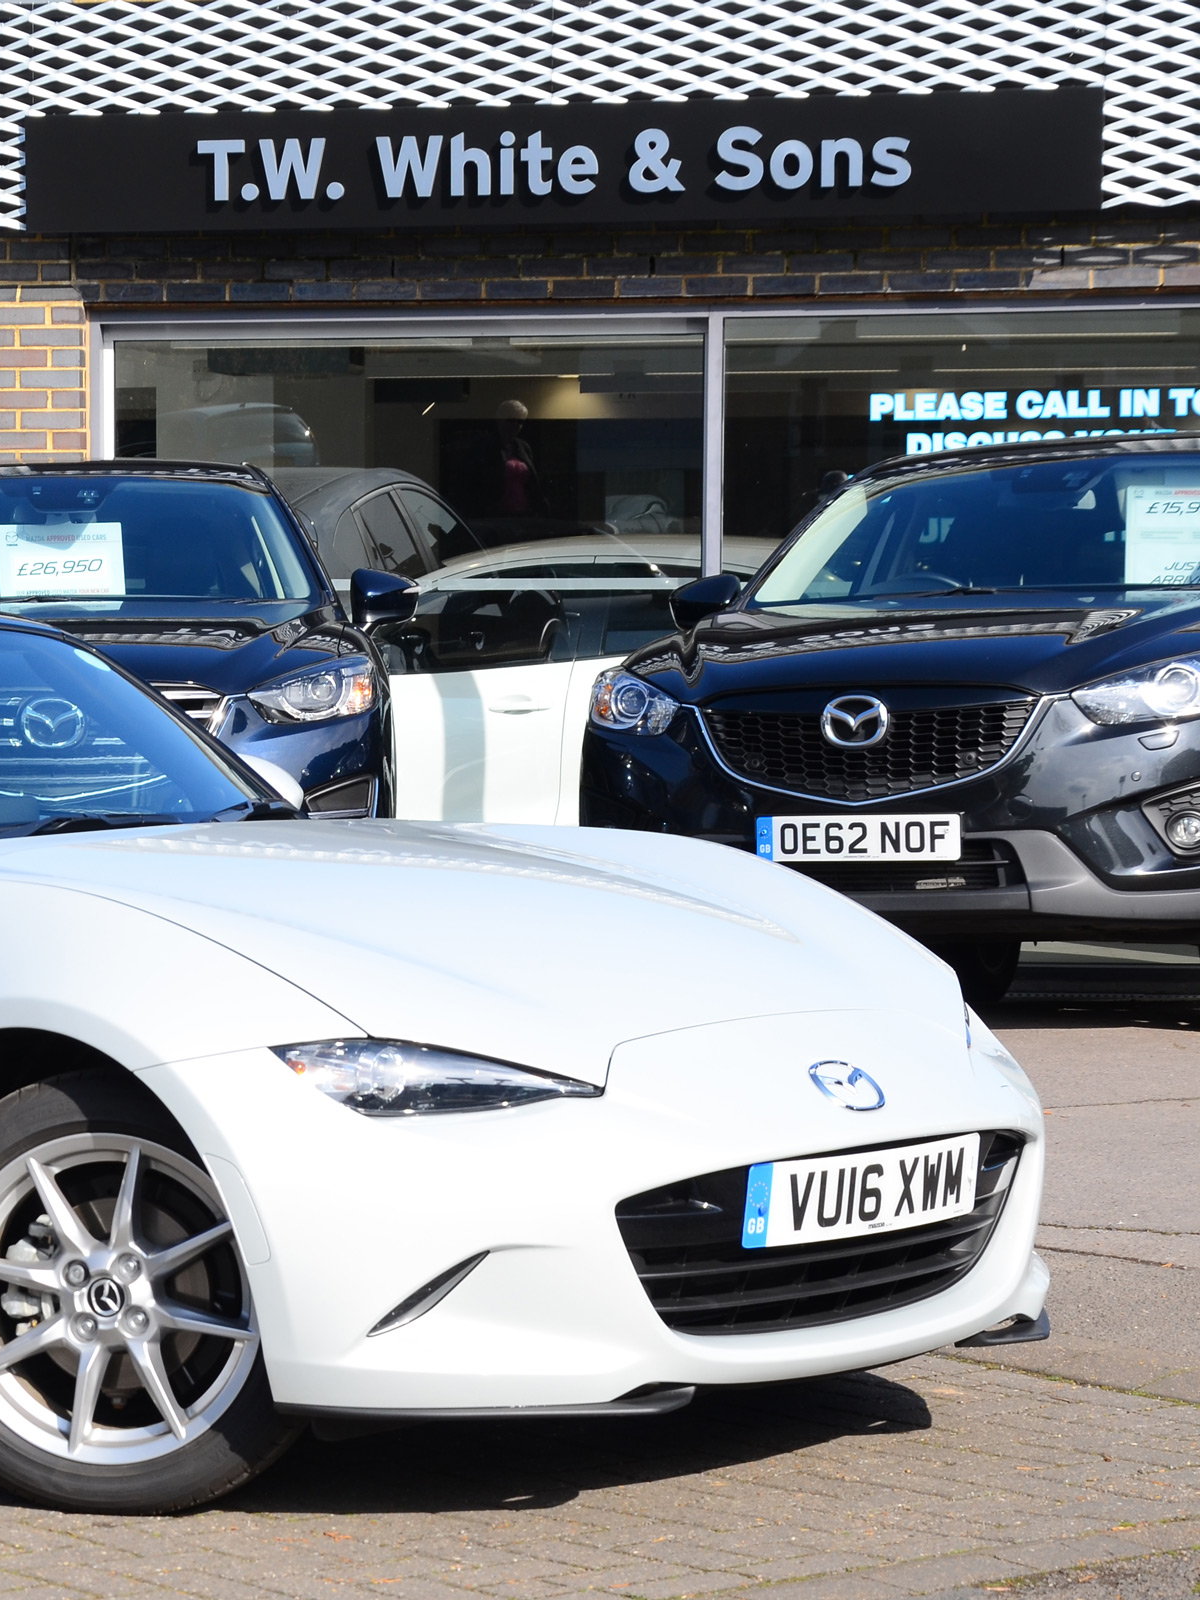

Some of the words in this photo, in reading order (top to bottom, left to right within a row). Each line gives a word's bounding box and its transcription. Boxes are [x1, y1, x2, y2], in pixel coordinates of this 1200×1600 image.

[197, 137, 345, 201] T.W.
[376, 130, 599, 197] White
[628, 128, 686, 193] &
[714, 125, 912, 191] Sons
[869, 391, 1008, 421] PLEASE
[1015, 389, 1111, 419] CALL
[1119, 388, 1160, 417] IN
[1168, 388, 1200, 416] T
[46, 534, 75, 542] APPROVED
[16, 558, 103, 577] £26,950
[759, 844, 771, 853] GB
[780, 822, 868, 854] OE62
[880, 821, 950, 853] NOF
[790, 1163, 884, 1232] VU16
[894, 1147, 965, 1217] XWM
[746, 1216, 765, 1234] GB
